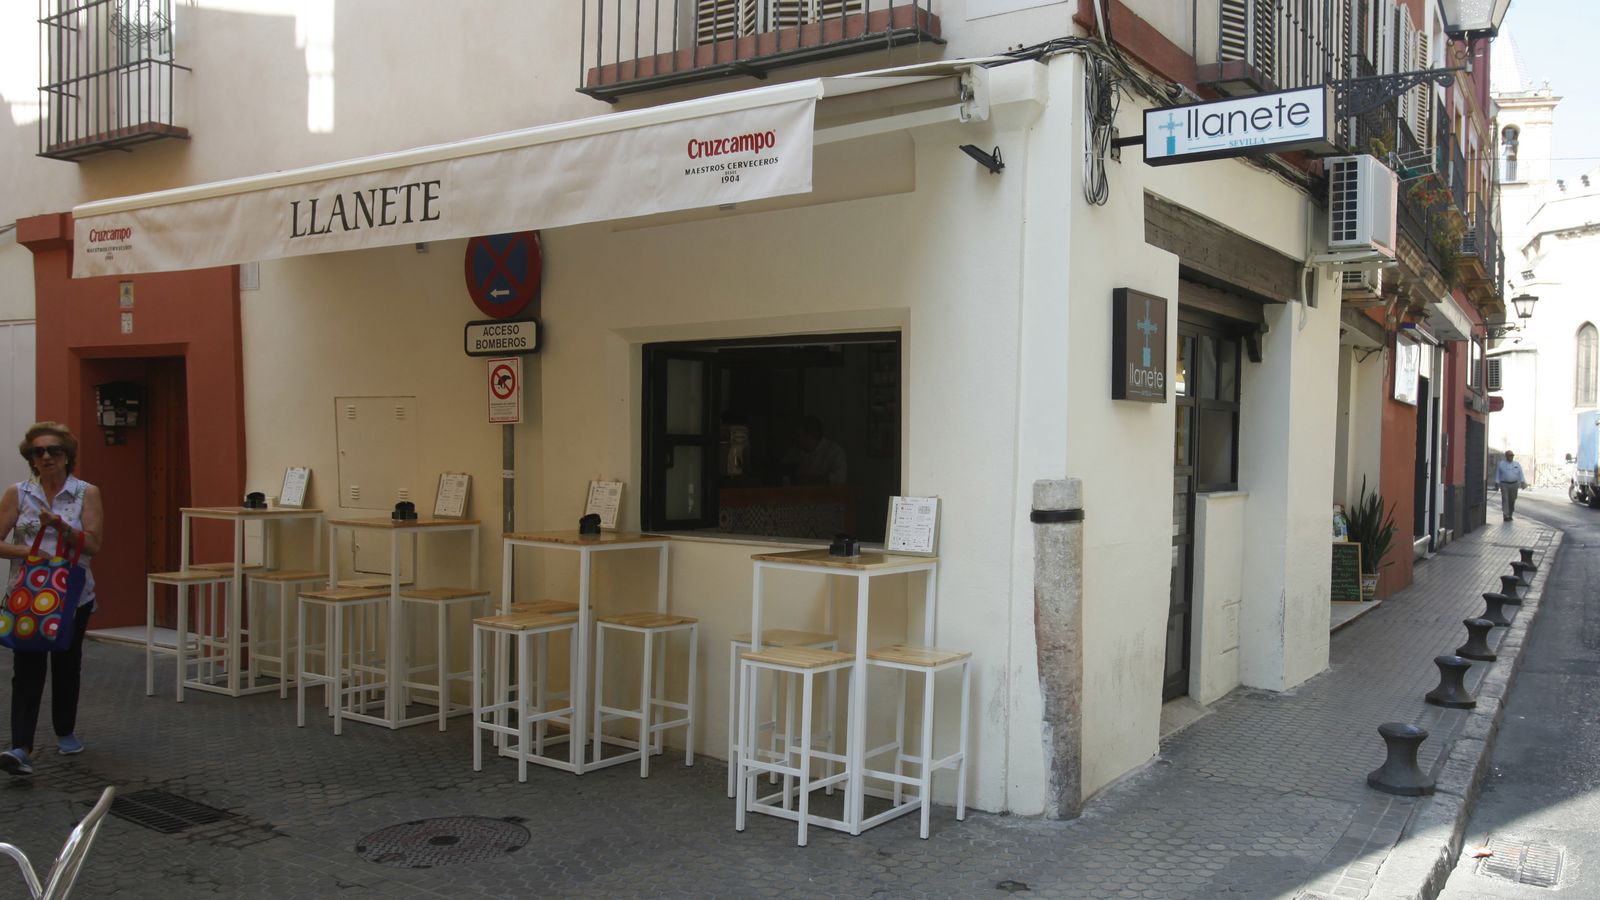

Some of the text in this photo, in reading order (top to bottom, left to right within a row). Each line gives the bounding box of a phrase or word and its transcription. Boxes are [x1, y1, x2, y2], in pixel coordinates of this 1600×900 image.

[1187, 97, 1310, 139] llanete
[687, 130, 776, 159] Cruzcampo
[1229, 137, 1266, 148] SEVILLA
[685, 157, 779, 175] MAESTROS CERVECEROS
[721, 175, 740, 184] 1904
[289, 180, 441, 239] LLANETE
[483, 324, 520, 337] ACCESO
[475, 337, 527, 350] BOMBEROS
[1129, 362, 1164, 389] llanete
